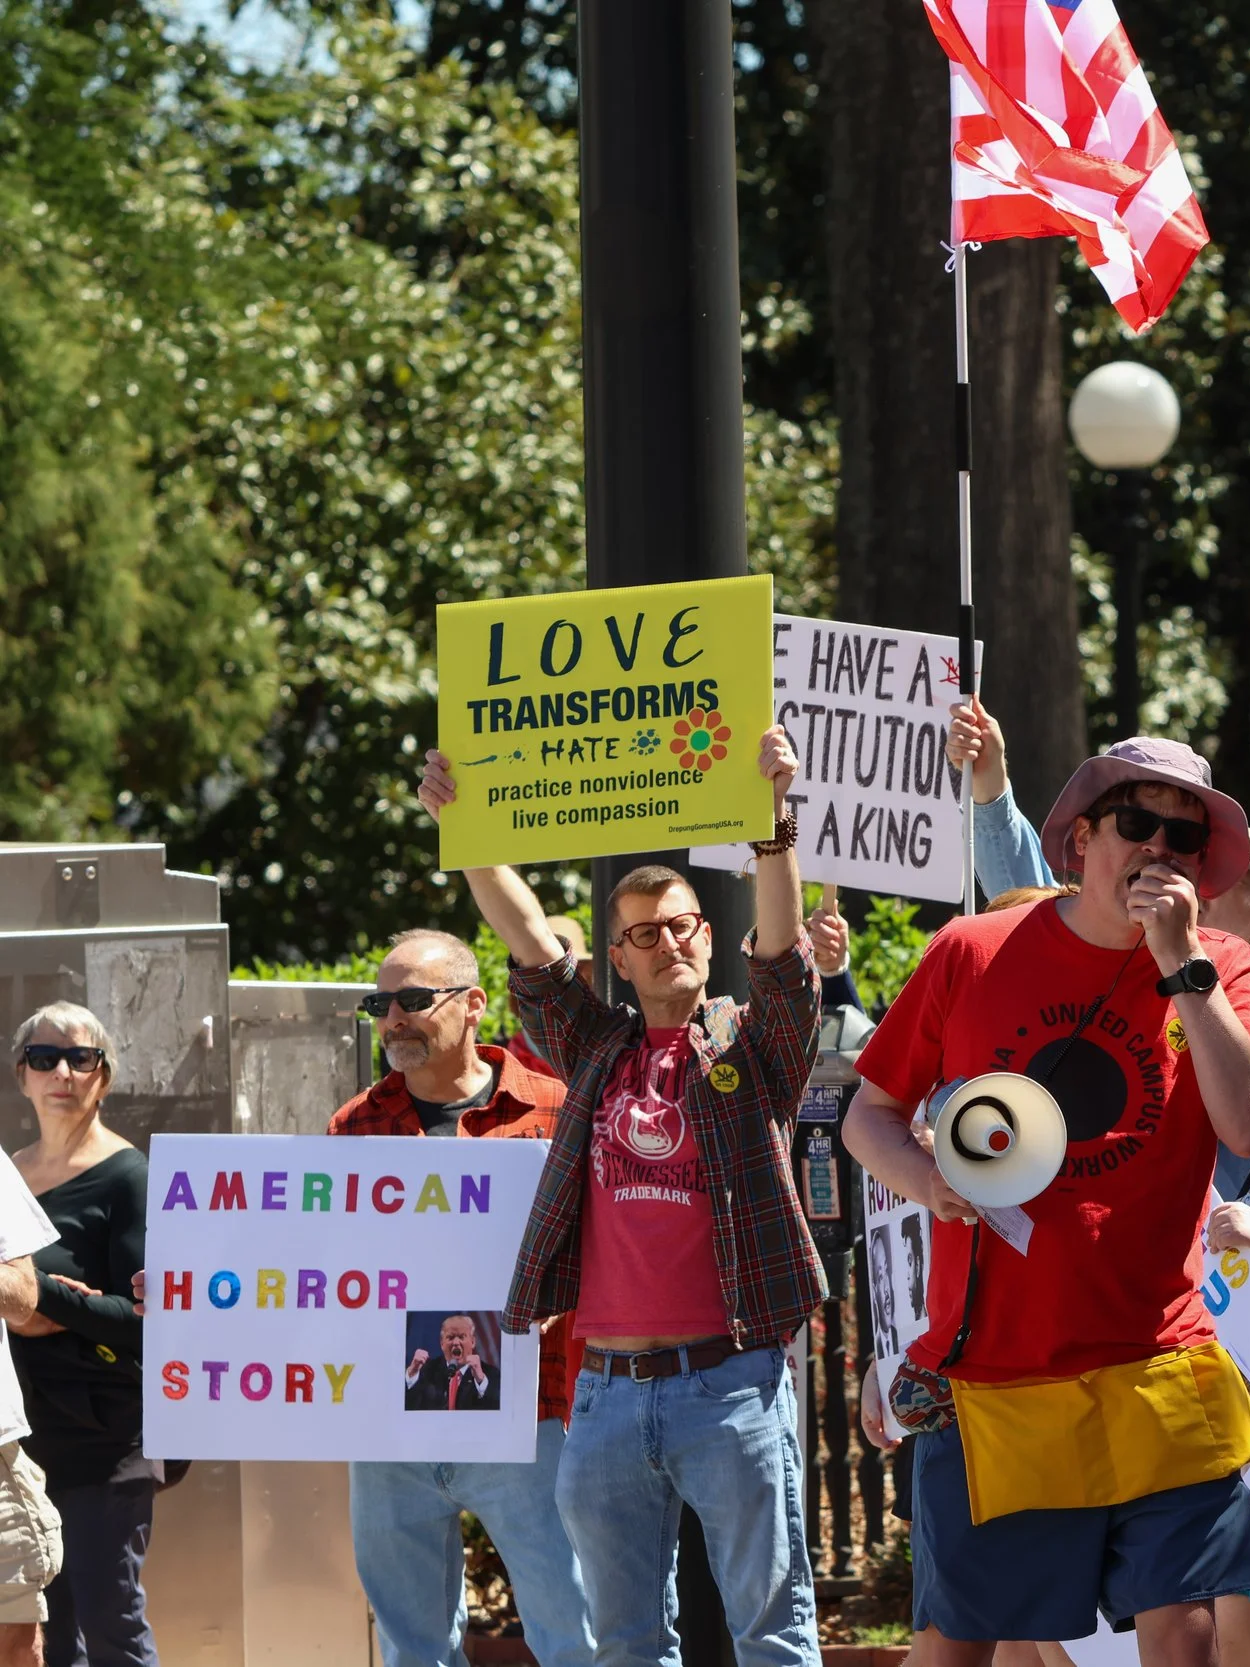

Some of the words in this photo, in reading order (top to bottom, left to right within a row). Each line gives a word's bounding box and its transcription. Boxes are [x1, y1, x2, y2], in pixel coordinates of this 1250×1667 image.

[488, 606, 704, 687] LOVE
[773, 623, 792, 689] E
[808, 629, 898, 701] HAVE
[907, 643, 933, 707] A
[468, 679, 719, 733] TRANSFORMS
[541, 736, 620, 767] HATE
[776, 700, 961, 804] STITUTION
[488, 776, 572, 806] practice
[580, 769, 703, 796] nonviolence
[512, 806, 549, 830] live
[555, 797, 680, 826] compassion
[816, 800, 841, 857] A
[850, 802, 932, 869] KING
[1039, 1003, 1129, 1040] UNIED
[1125, 1033, 1164, 1135] CAMPUS
[1057, 1136, 1144, 1178] WORK
[162, 1171, 491, 1214] AMERICAN
[614, 1185, 692, 1206] TRADEMARK
[164, 1268, 407, 1310] HORROR
[162, 1360, 355, 1403] STORY
